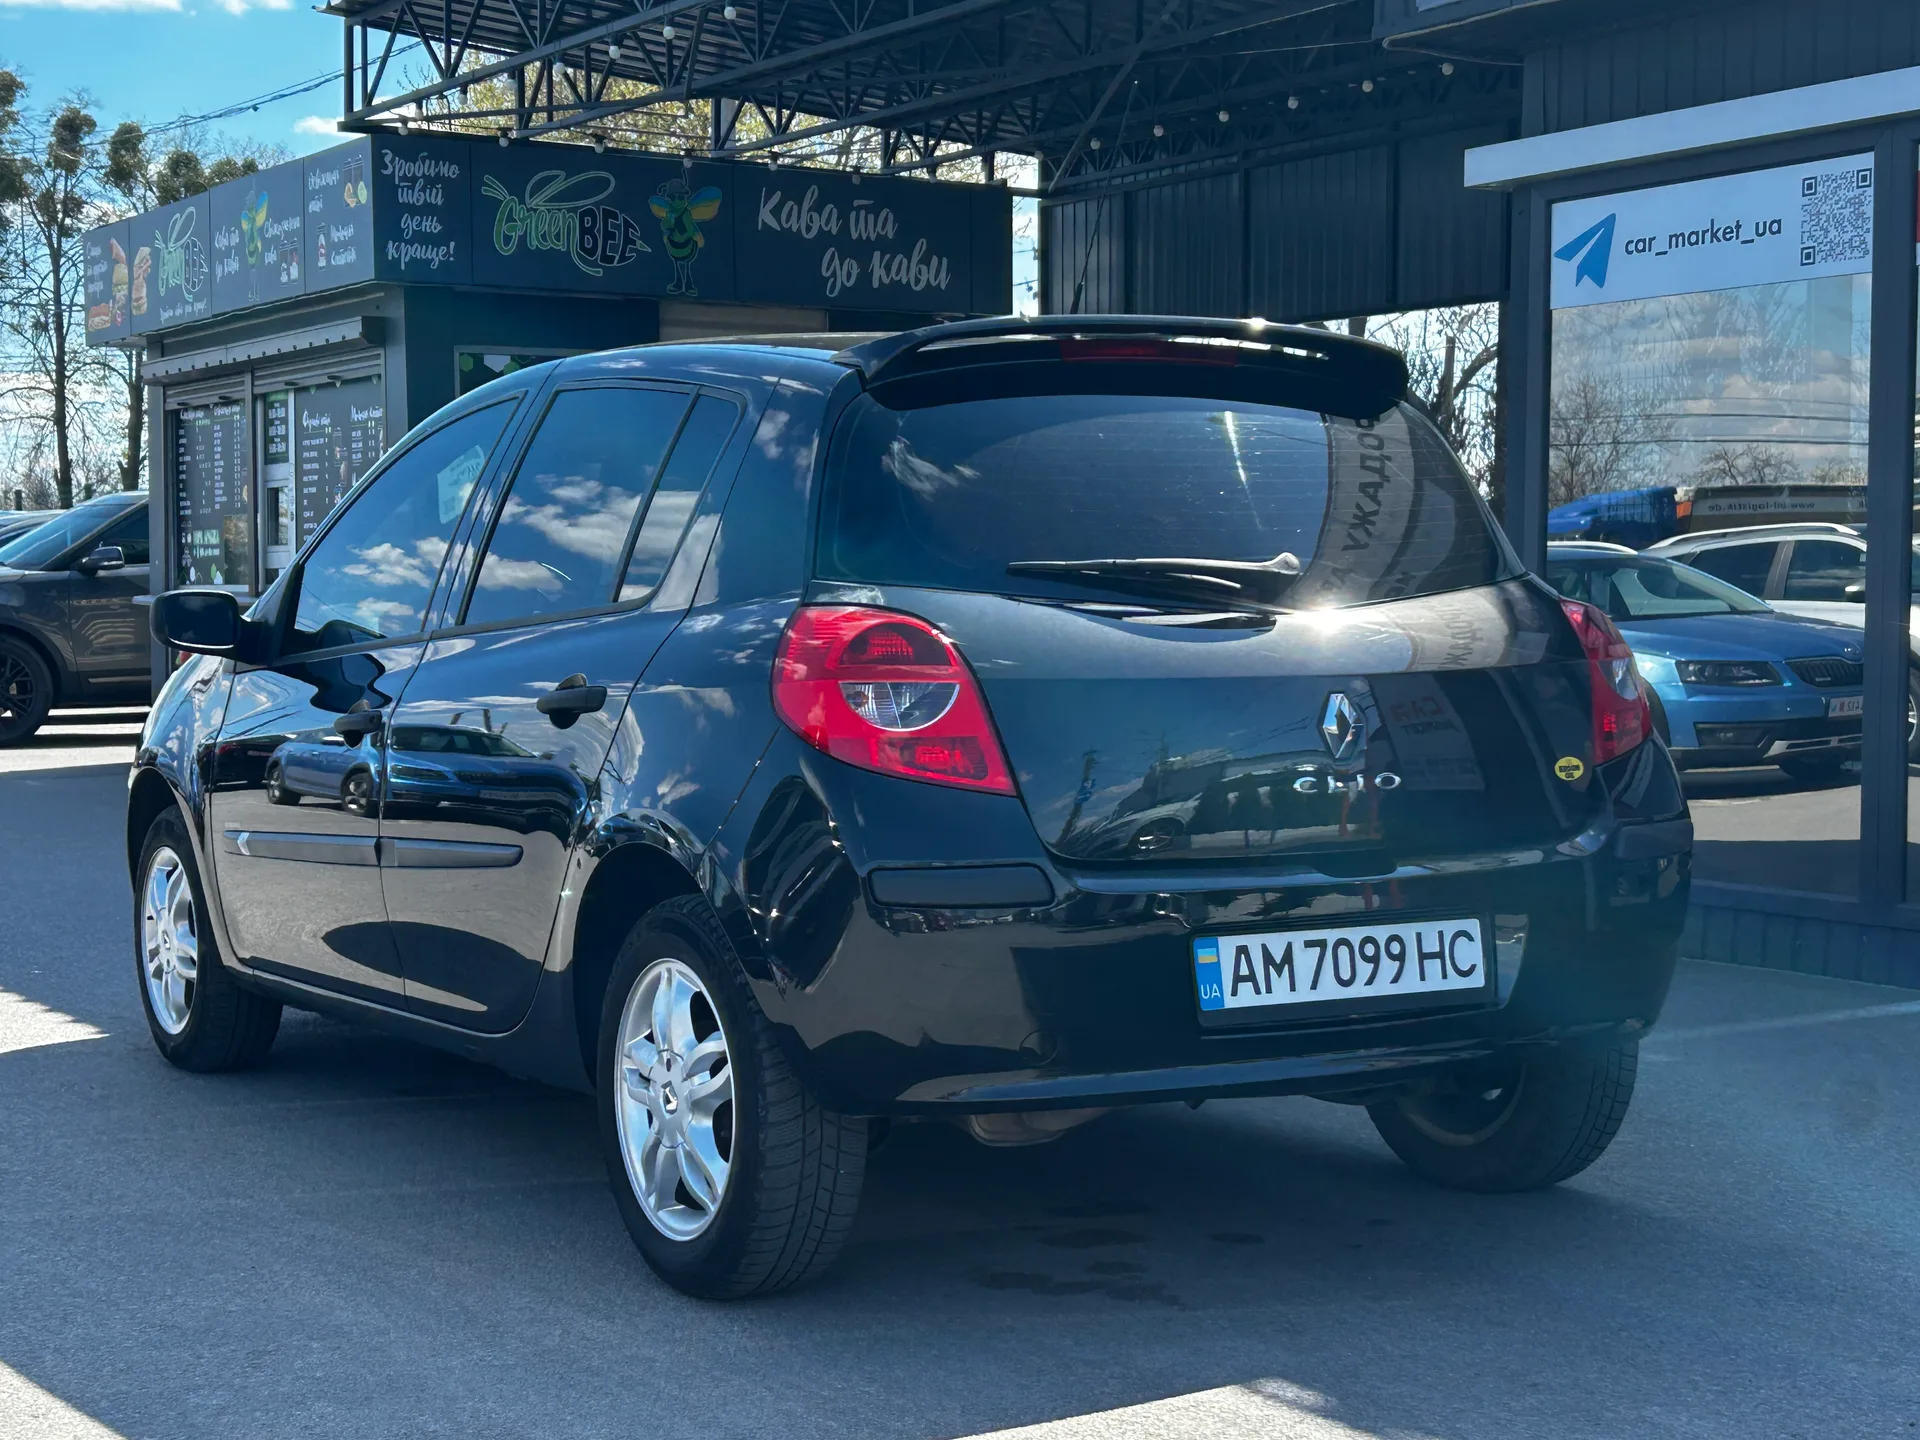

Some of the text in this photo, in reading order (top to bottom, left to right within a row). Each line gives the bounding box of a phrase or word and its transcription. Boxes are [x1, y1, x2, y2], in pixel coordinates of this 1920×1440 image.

[380, 149, 460, 184] Зробимо
[397, 178, 444, 207] твій
[400, 214, 443, 240] день
[757, 184, 899, 241] Кава та
[1624, 217, 1783, 257] car_market_ua
[385, 241, 456, 271] краще!
[821, 238, 951, 298] до кави
[1200, 984, 1221, 1000] UA
